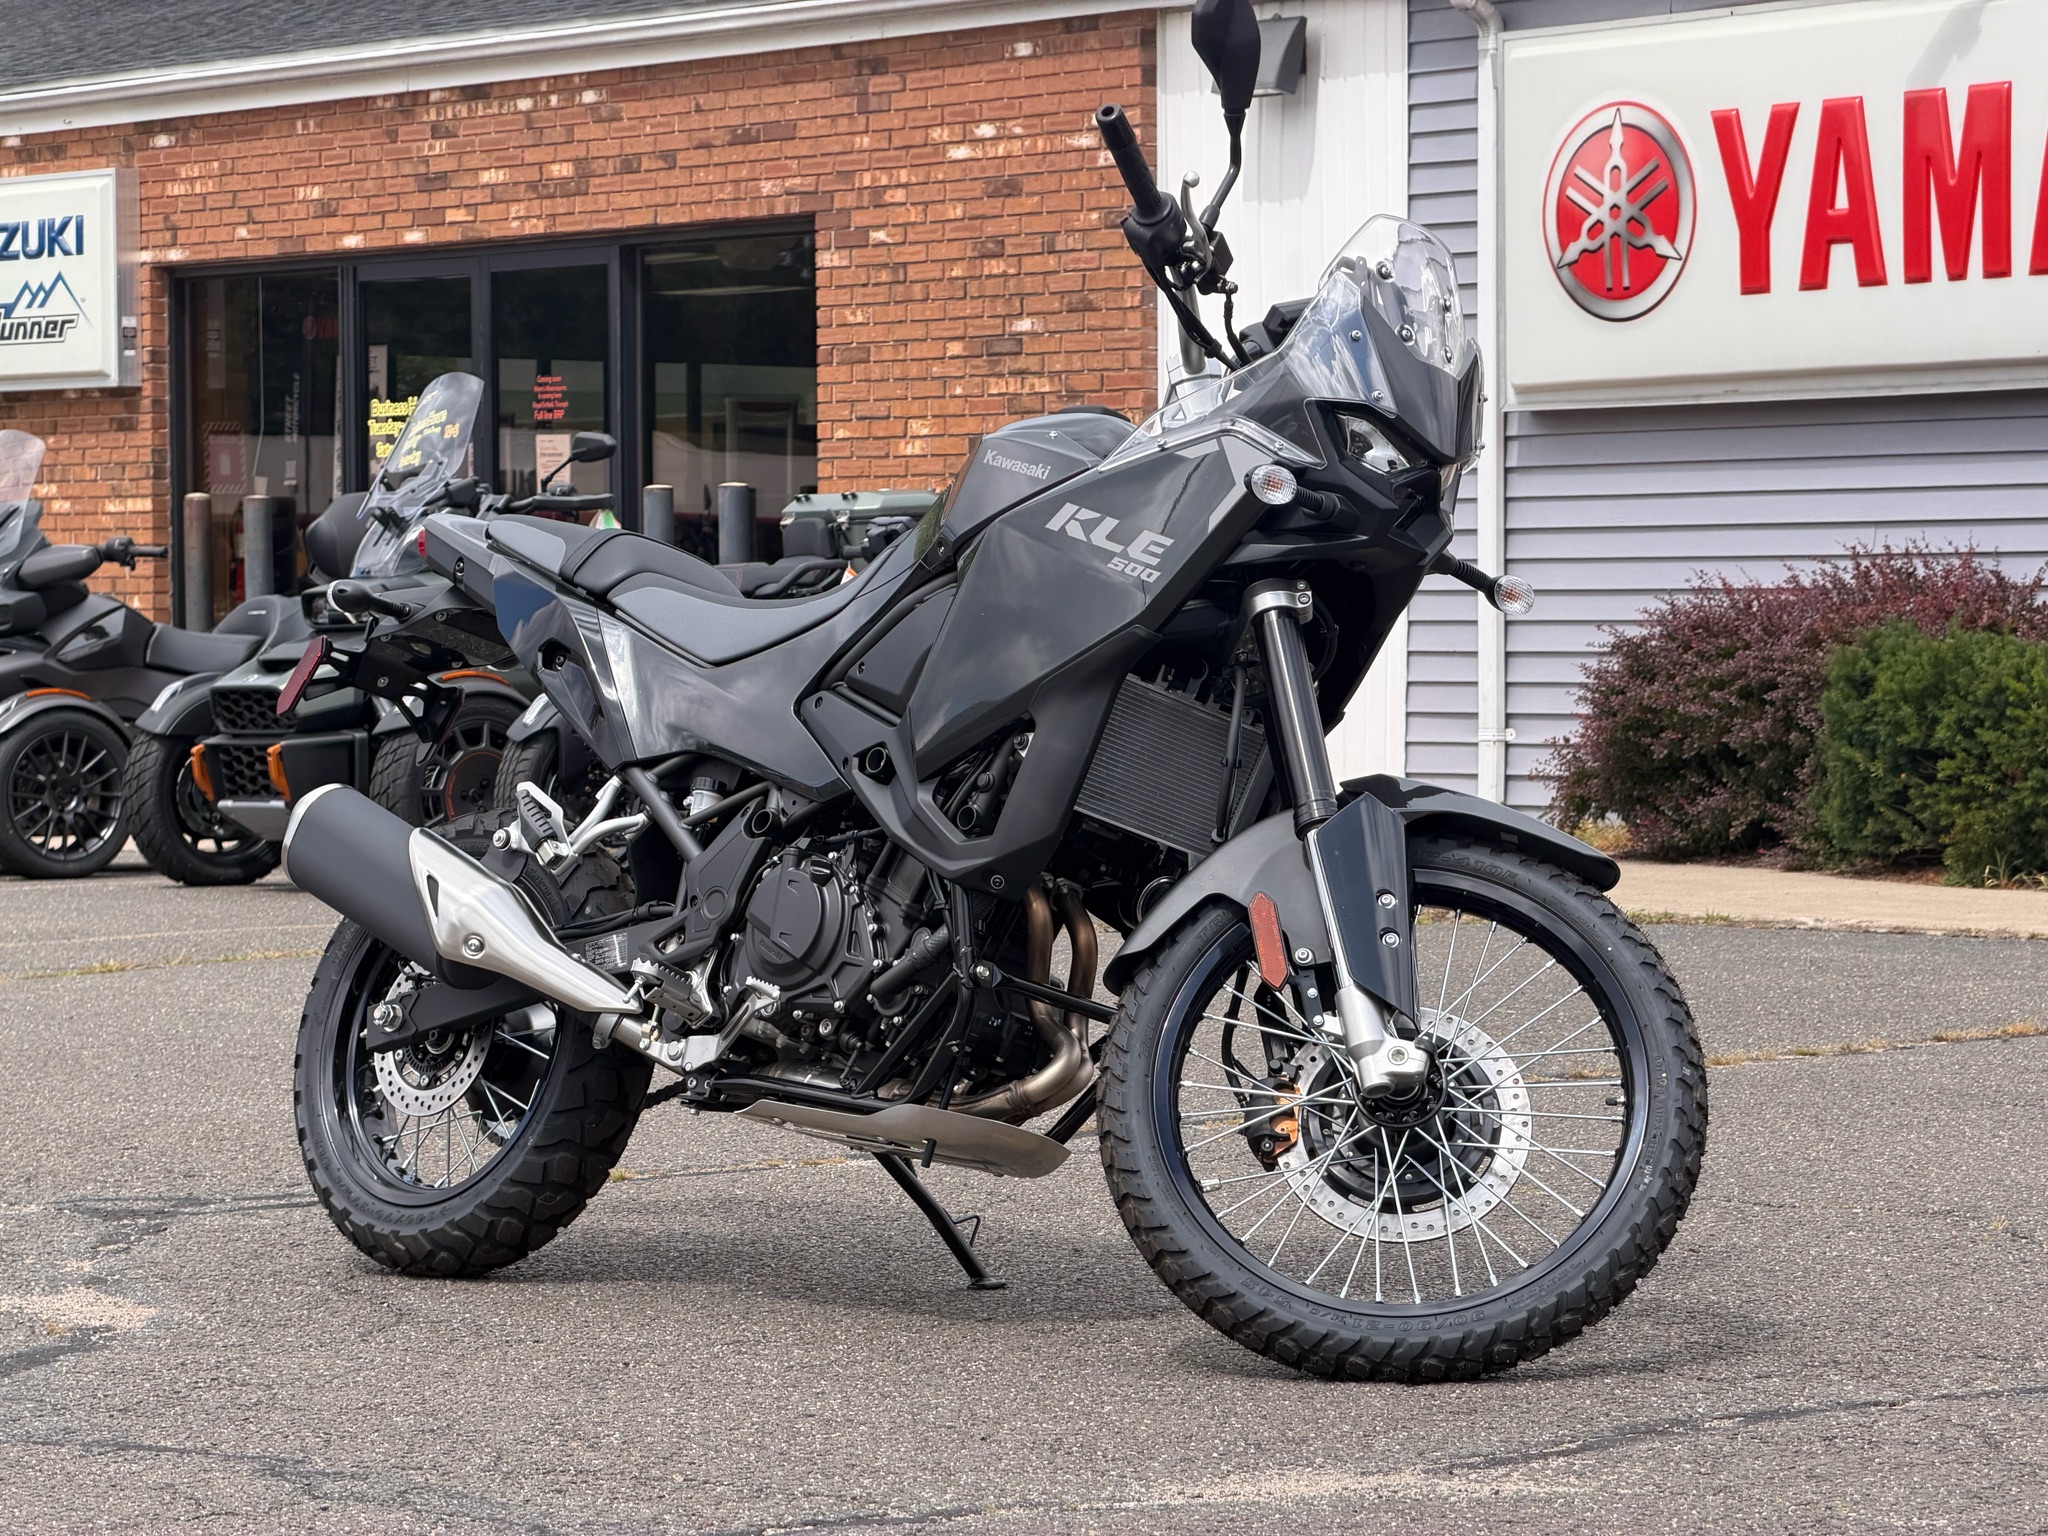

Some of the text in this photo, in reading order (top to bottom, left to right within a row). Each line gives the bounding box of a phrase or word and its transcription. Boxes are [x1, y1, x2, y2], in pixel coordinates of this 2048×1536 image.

[1710, 80, 2048, 296] YAM
[0, 214, 84, 261] ZUKI
[0, 313, 76, 341] unner
[371, 398, 408, 417] Business
[983, 449, 1050, 480] Kawasaki
[1045, 502, 1175, 566] KLE
[1106, 556, 1162, 583] 500
[1239, 1276, 1293, 1309] 54S
[1350, 1309, 1487, 1333] 90/90-21
